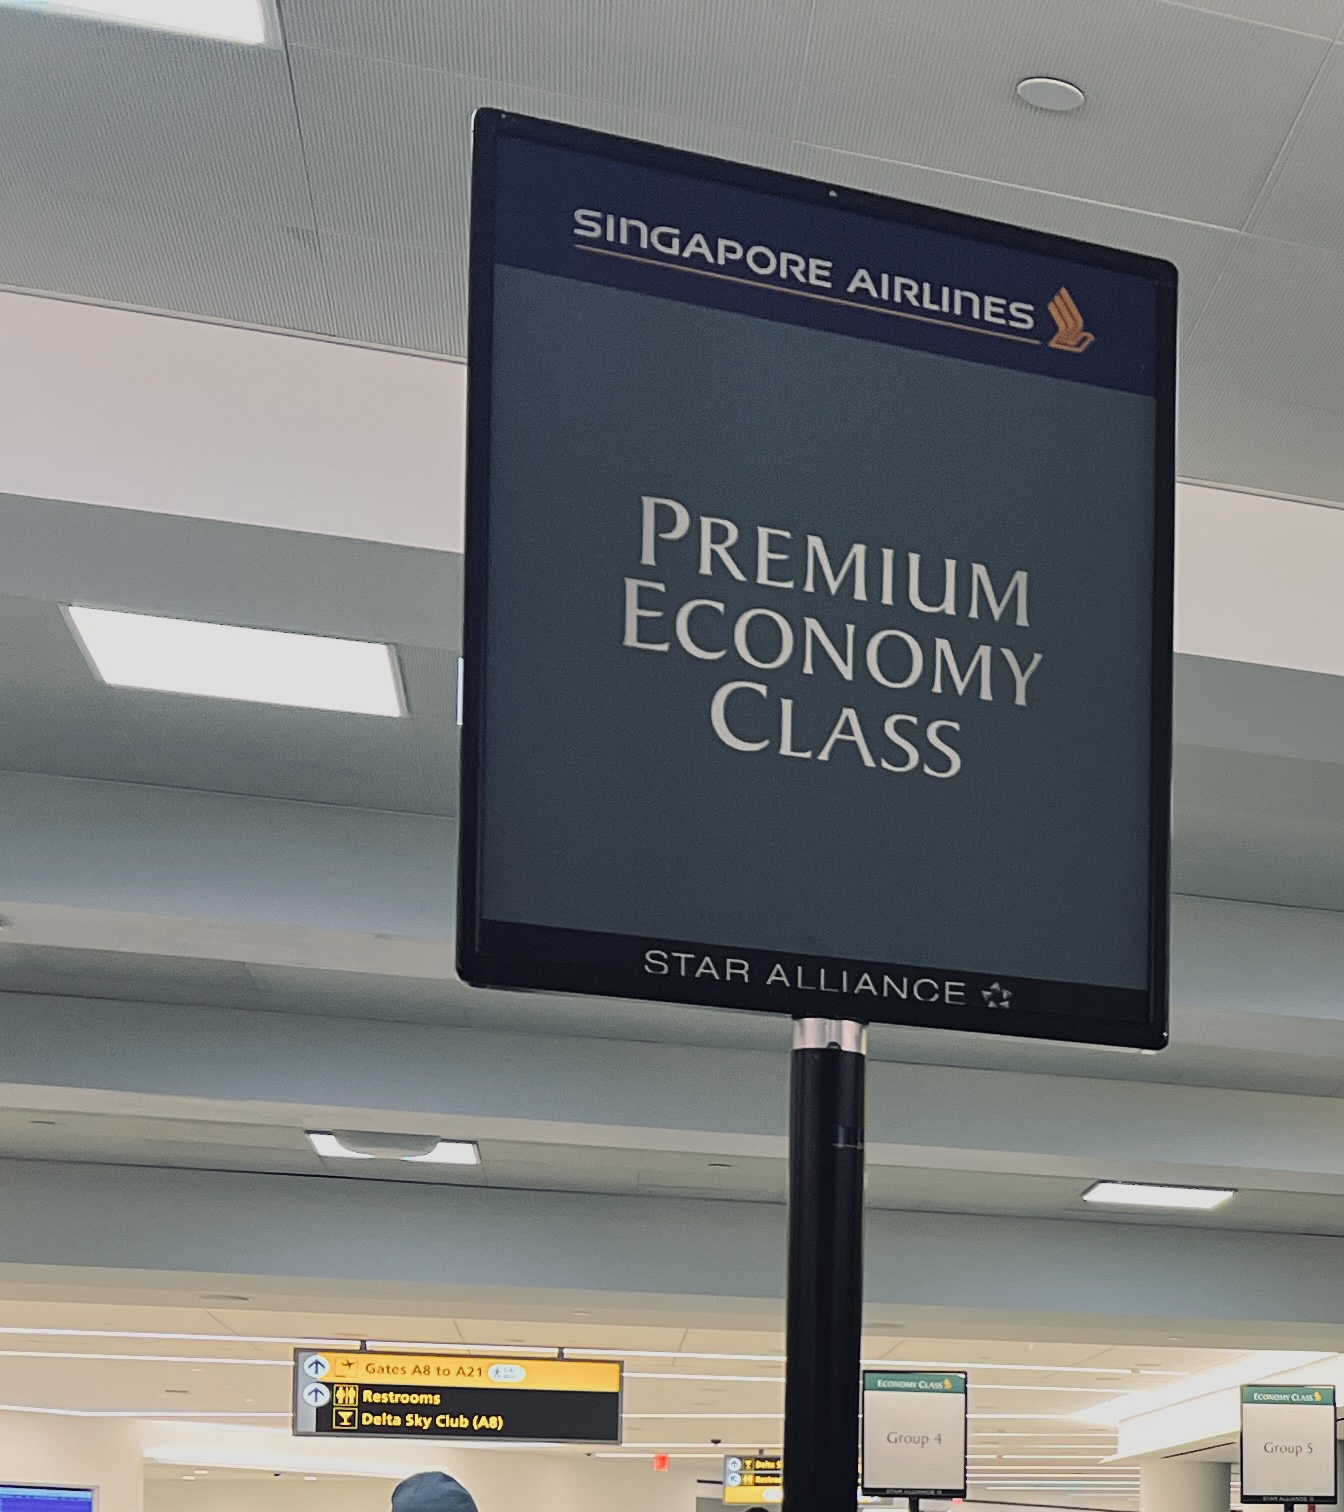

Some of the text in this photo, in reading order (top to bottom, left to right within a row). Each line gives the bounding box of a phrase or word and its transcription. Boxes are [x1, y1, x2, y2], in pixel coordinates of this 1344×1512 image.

[573, 207, 1035, 331] SINGAPORE AIRLINES
[640, 495, 1030, 628] PREMIUM
[623, 576, 1043, 707] ECONOMY
[710, 680, 963, 779] CLASS
[644, 949, 967, 1006] STAR ALLIANCE
[365, 1362, 483, 1378] Gates A8 to A21
[877, 1379, 943, 1389] ECONOMY CLASS
[362, 1389, 441, 1405] Restrooms
[1253, 1392, 1314, 1402] ECONOMY CLASS
[361, 1413, 504, 1431] Delta Sky Club (A8)
[886, 1432, 942, 1448] Group 4
[1263, 1442, 1313, 1457] Group 5
